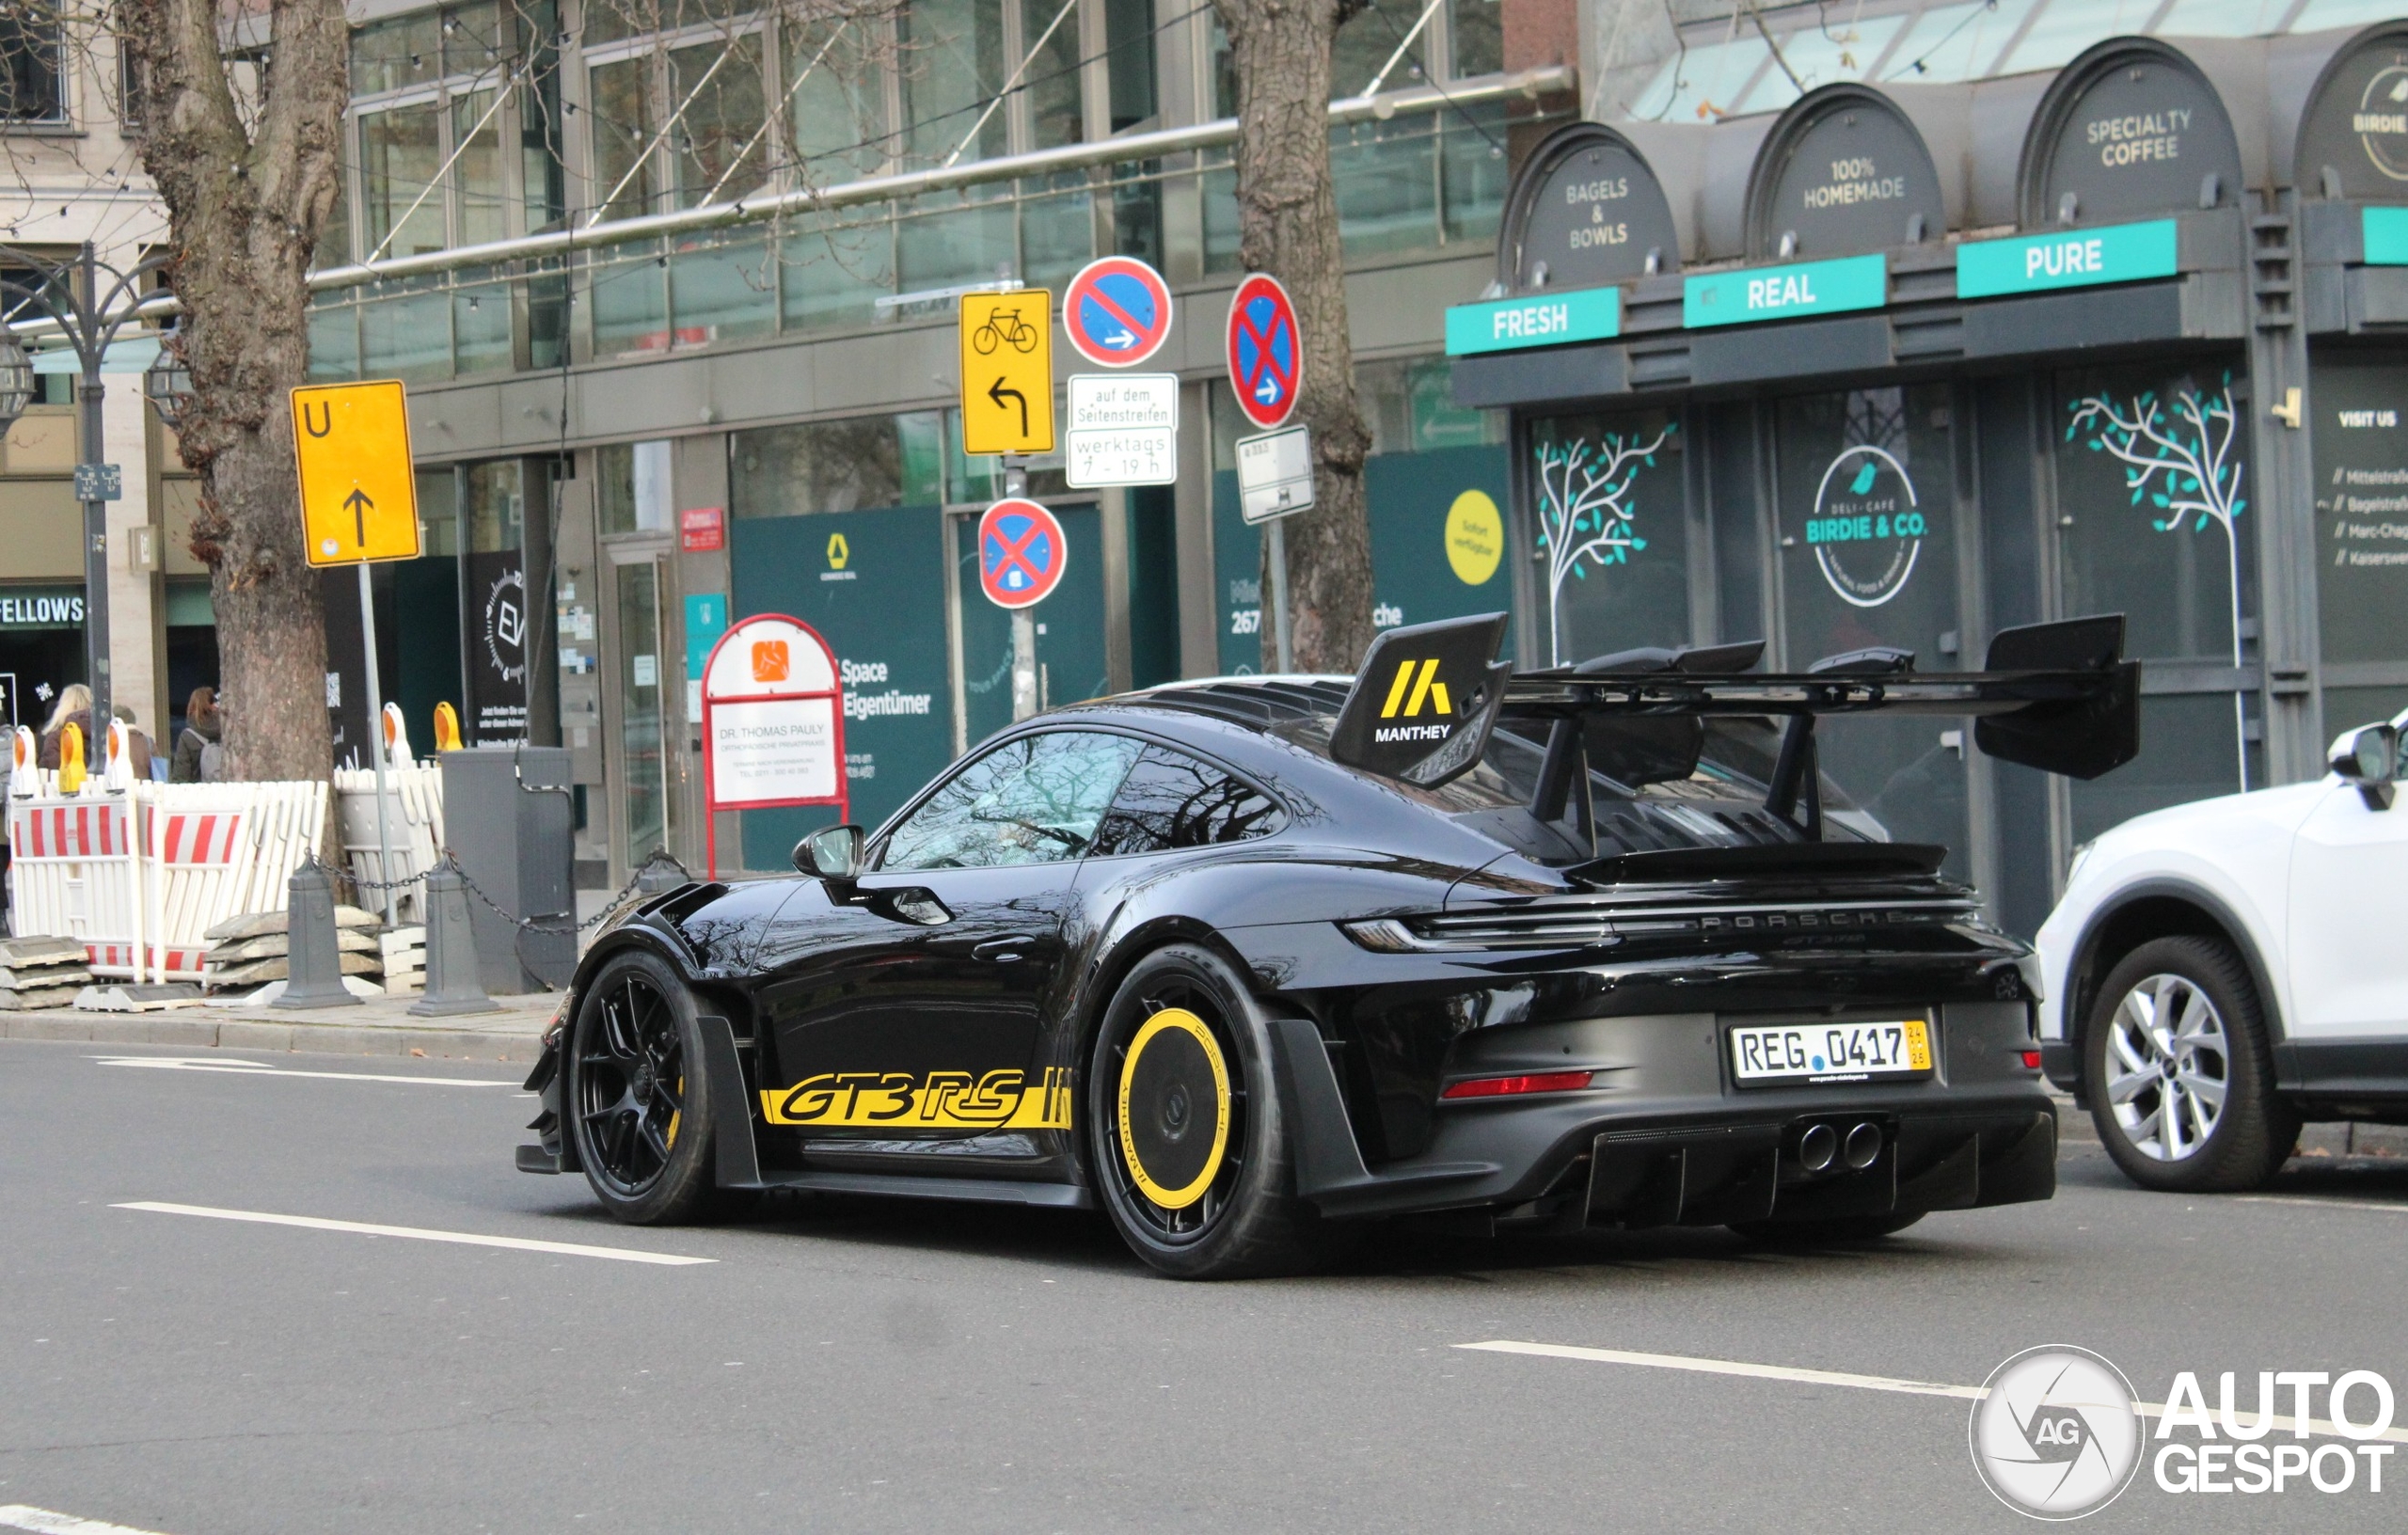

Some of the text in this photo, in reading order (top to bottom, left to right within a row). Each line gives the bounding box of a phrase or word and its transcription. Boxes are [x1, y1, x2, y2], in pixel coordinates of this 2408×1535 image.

[2086, 109, 2193, 145] SPECIALTY
[2353, 113, 2407, 134] BIRDIE
[2101, 136, 2179, 167] COFFEE
[1830, 157, 1876, 181] 100%
[1566, 178, 1629, 205] BAGELS
[1803, 176, 1905, 209] HOMEMADE
[1592, 205, 1604, 223] &
[1569, 222, 1628, 249] BOWLS
[2026, 239, 2103, 279] PURE
[1747, 274, 1816, 309] REAL
[1493, 304, 1569, 340] FRESH
[1095, 388, 1150, 403] auf dem
[303, 401, 331, 438] U
[1077, 407, 1168, 422] Seitenstreifen
[2337, 410, 2397, 427] VISIT US
[1076, 437, 1165, 456] werktags
[1121, 459, 1139, 475] 19
[1463, 520, 1488, 537] Sofort
[1806, 513, 1928, 544] BIRDIE & CO.
[1453, 538, 1494, 557] verfügbar
[0, 597, 84, 623] ELLOWS
[1230, 609, 1260, 634] 267
[1373, 602, 1402, 627] che
[843, 689, 931, 720] Eigentümer
[721, 724, 825, 739] DR. THOMAS PAULY
[1374, 724, 1451, 743] MANTHEY
[1701, 910, 1905, 929] PORSCHE
[1908, 1026, 1921, 1038] 24
[1740, 1027, 1902, 1071] REG 0417
[1911, 1052, 1925, 1065] 25
[1195, 1024, 1228, 1147] PORSCHE
[1121, 1082, 1142, 1169] MANTHEY
